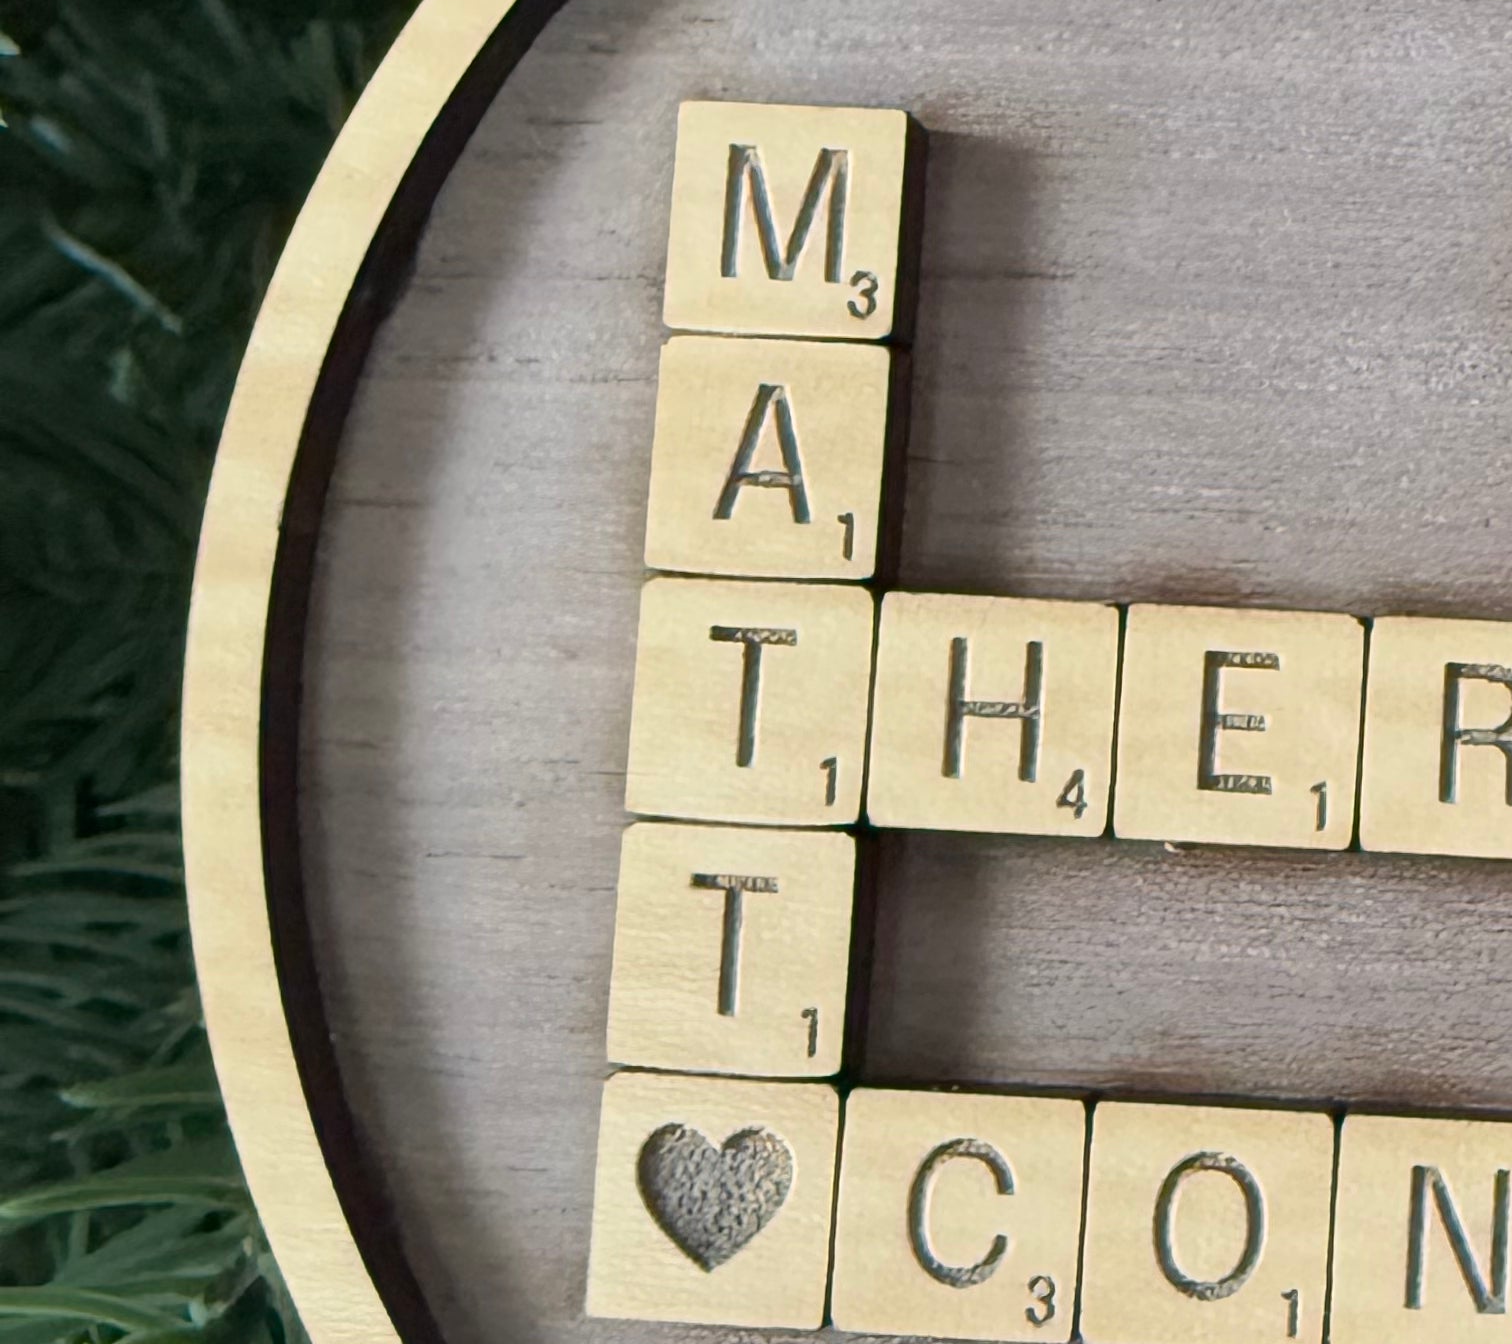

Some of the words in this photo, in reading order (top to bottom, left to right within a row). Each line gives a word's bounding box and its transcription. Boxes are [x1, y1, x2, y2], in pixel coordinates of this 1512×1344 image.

[846, 270, 880, 320] 3
[836, 511, 857, 563] 1
[688, 140, 846, 1020] MATT
[818, 755, 839, 808] 1
[1053, 767, 1089, 820] 4
[1308, 779, 1330, 832] 1
[799, 1006, 821, 1060] 1
[1023, 1273, 1058, 1327] 3
[1279, 1287, 1301, 1340] 1
